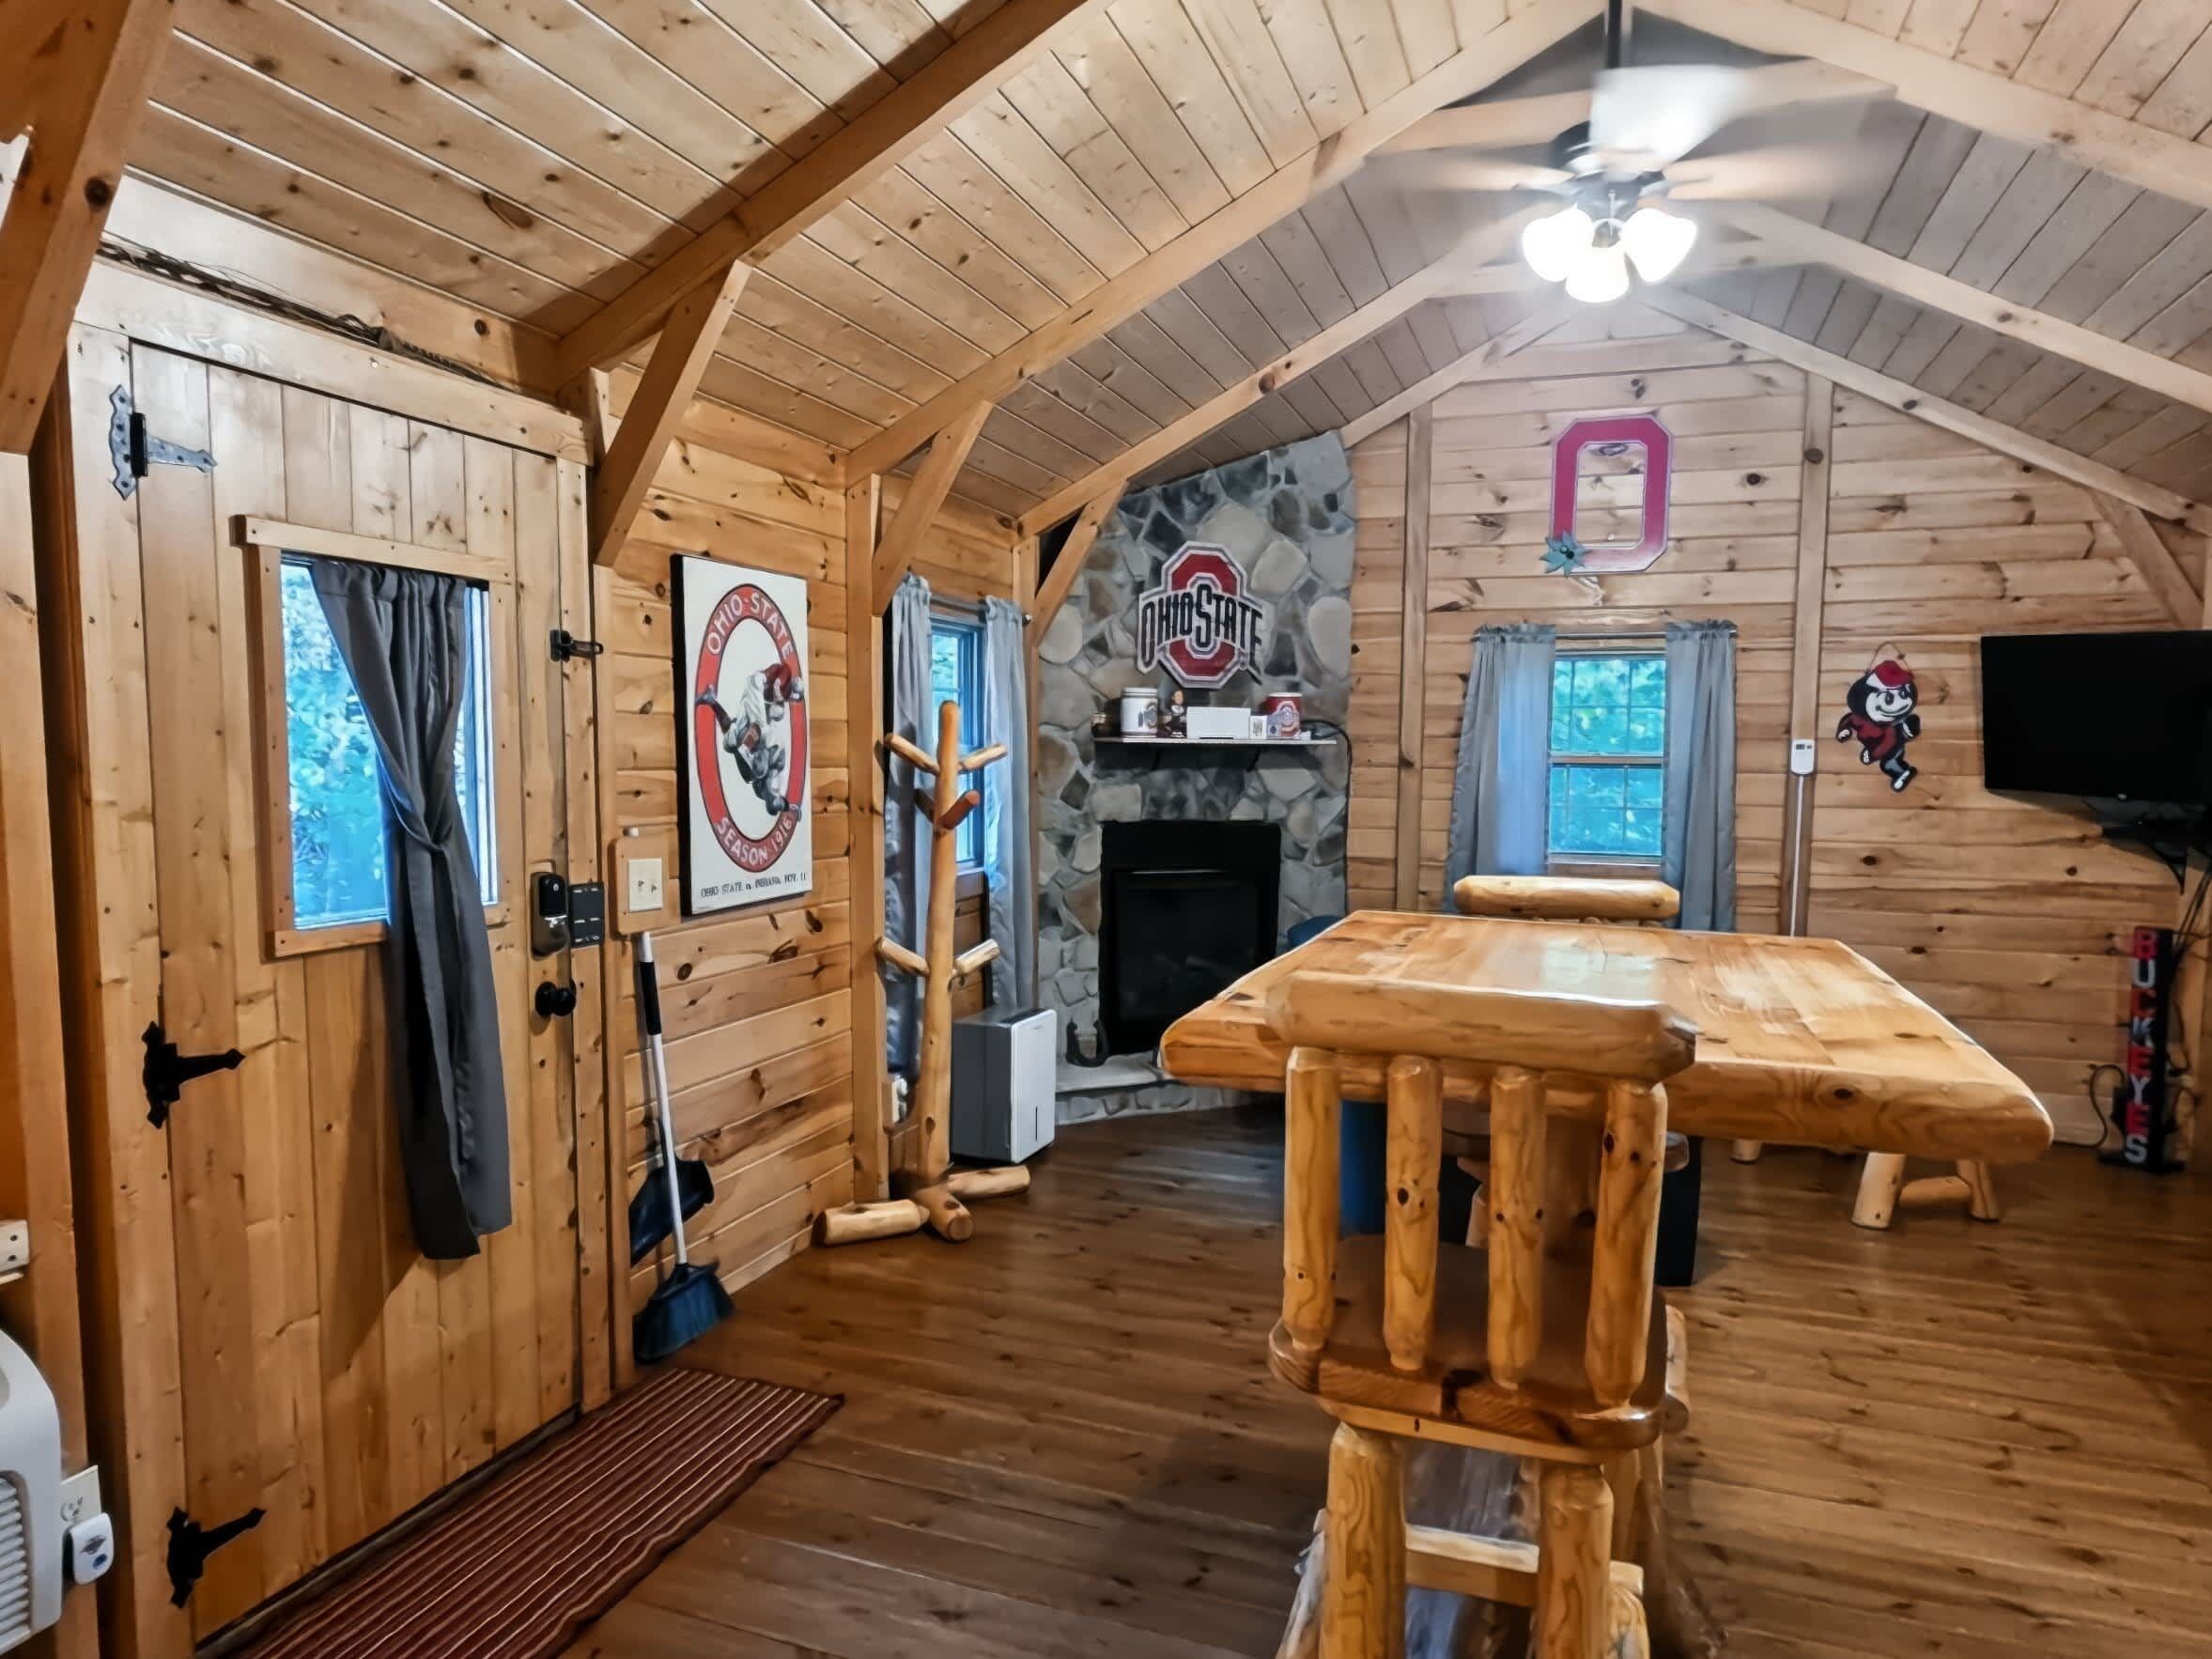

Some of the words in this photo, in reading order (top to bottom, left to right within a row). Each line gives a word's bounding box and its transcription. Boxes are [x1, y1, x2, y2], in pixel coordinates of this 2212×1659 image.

[707, 594, 743, 655] OHIO
[750, 592, 795, 660] STATE
[717, 816, 768, 866] SEASON
[721, 881, 743, 895] STATE
[2124, 927, 2158, 1164] BUCKEYES
